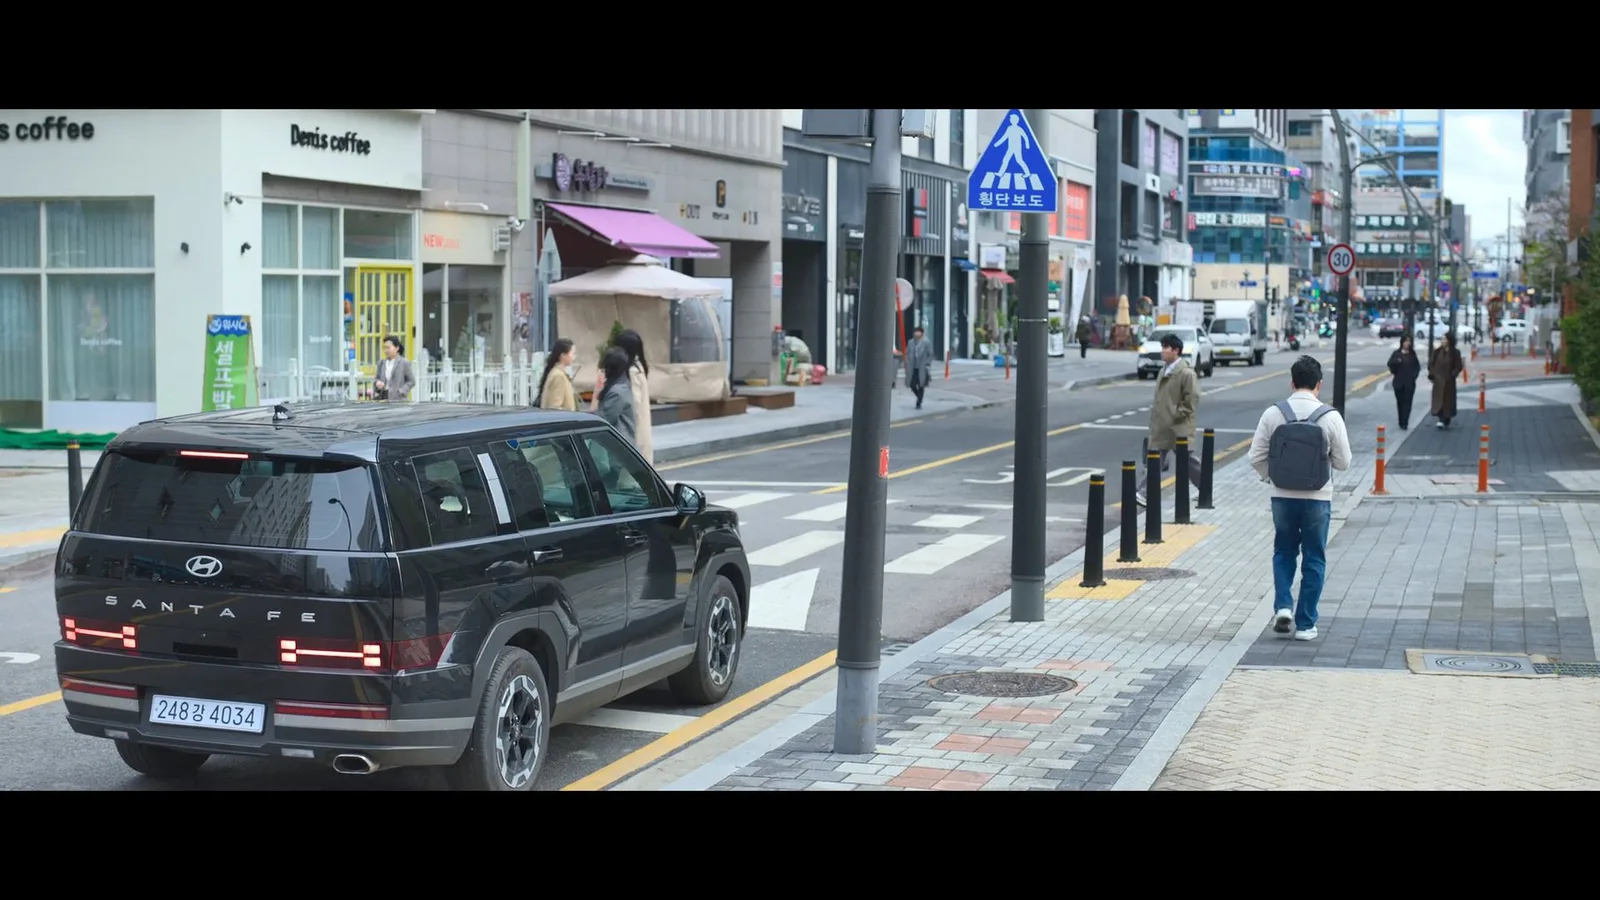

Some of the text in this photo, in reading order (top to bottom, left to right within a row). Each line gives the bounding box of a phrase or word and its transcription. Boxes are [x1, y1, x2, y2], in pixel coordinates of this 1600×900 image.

[15, 115, 95, 141] coffee
[290, 123, 371, 156] Denis coffee
[978, 191, 1044, 207] 횡단보도
[423, 234, 444, 249] NEW
[1333, 252, 1350, 267] 30
[105, 595, 316, 623] SANTA FE
[157, 699, 255, 727] 248강 4034
